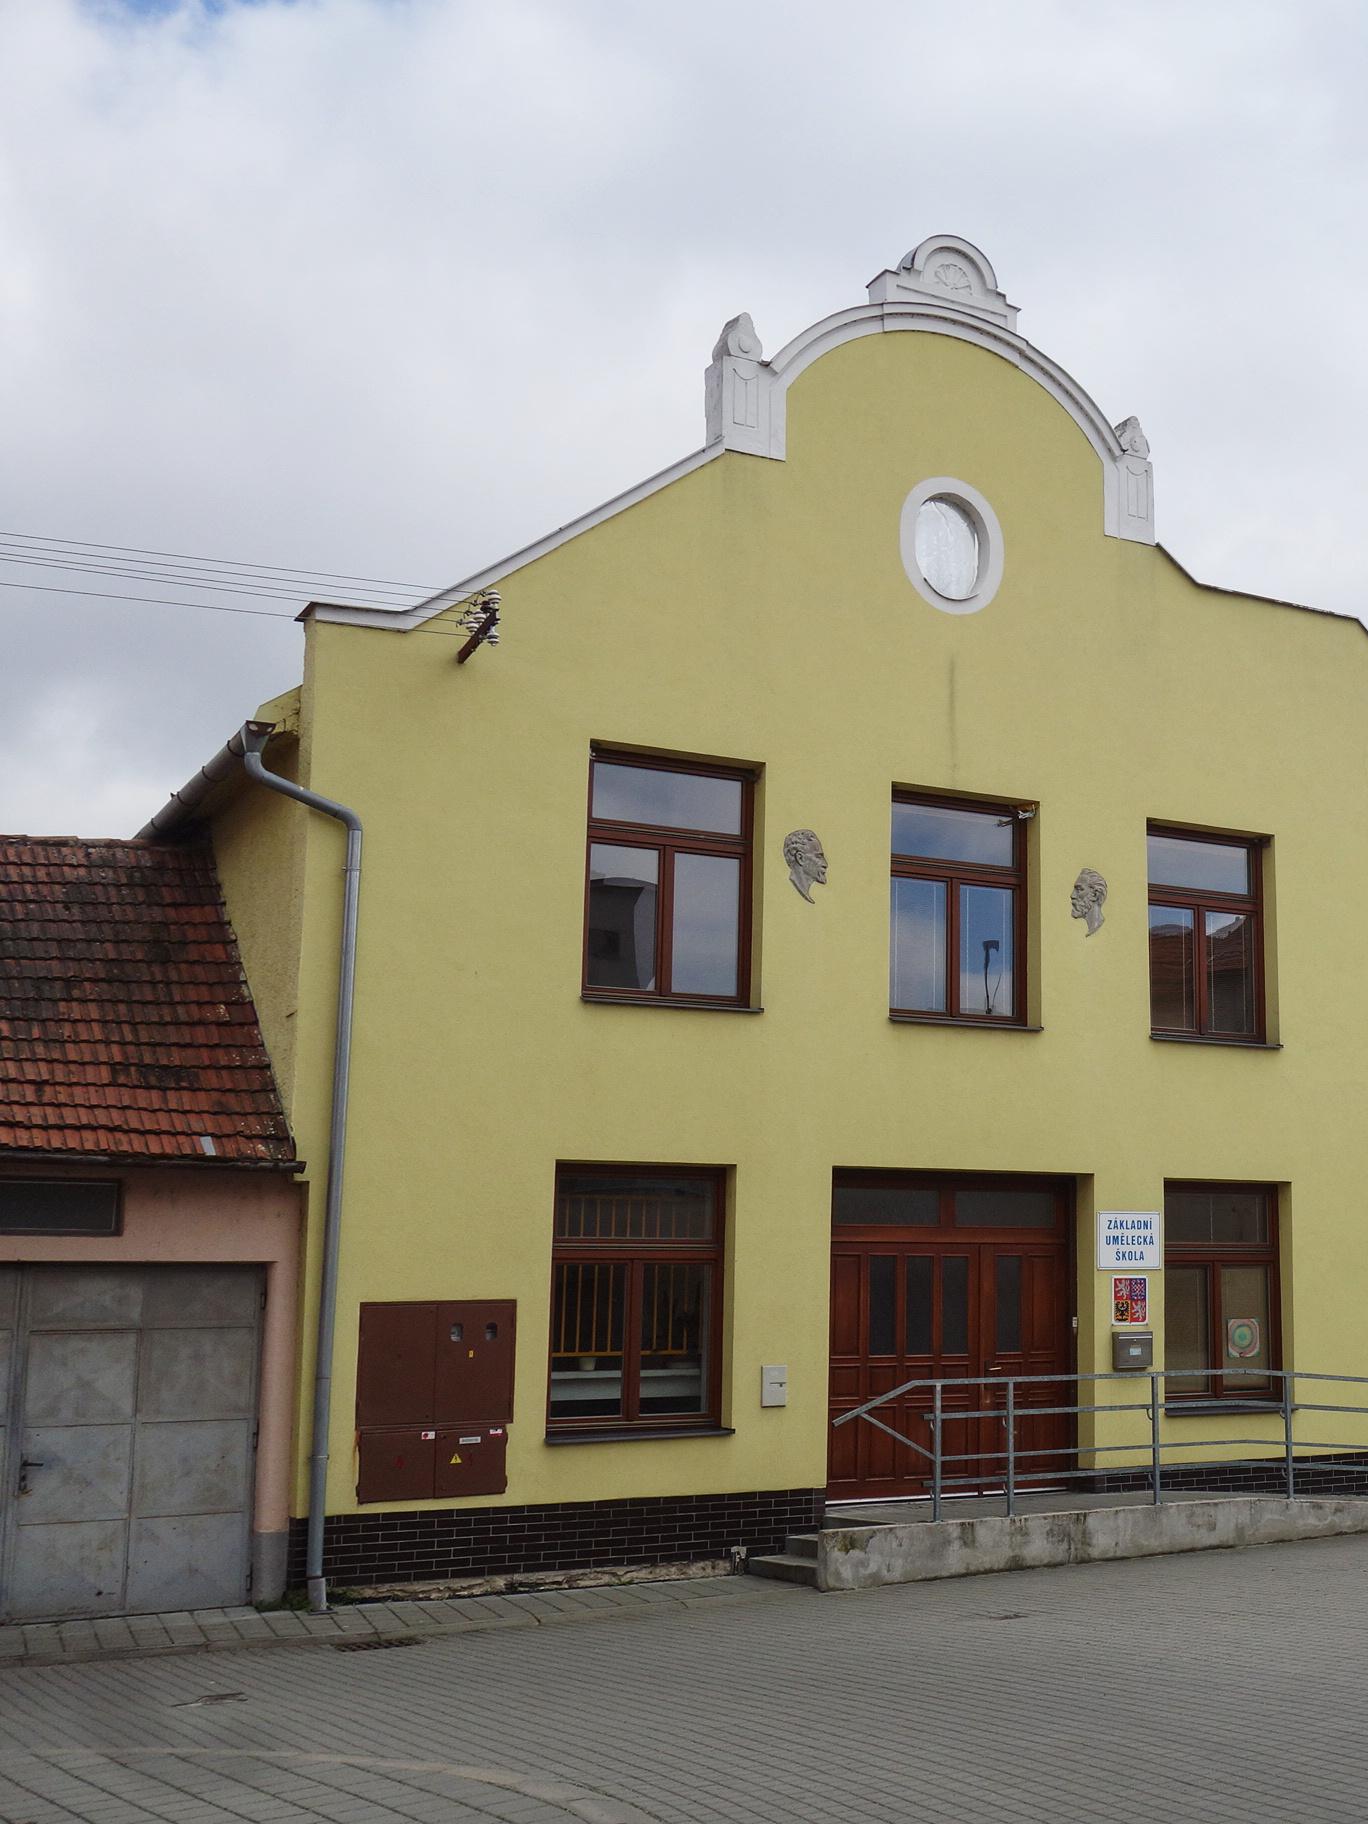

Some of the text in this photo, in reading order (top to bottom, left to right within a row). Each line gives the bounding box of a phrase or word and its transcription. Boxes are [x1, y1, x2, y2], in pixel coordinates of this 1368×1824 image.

[1107, 1217, 1152, 1230] ZÁKLADNÍ
[1105, 1232, 1154, 1246] UMĚLECKÁ
[1115, 1248, 1144, 1261] ŠKOLA
